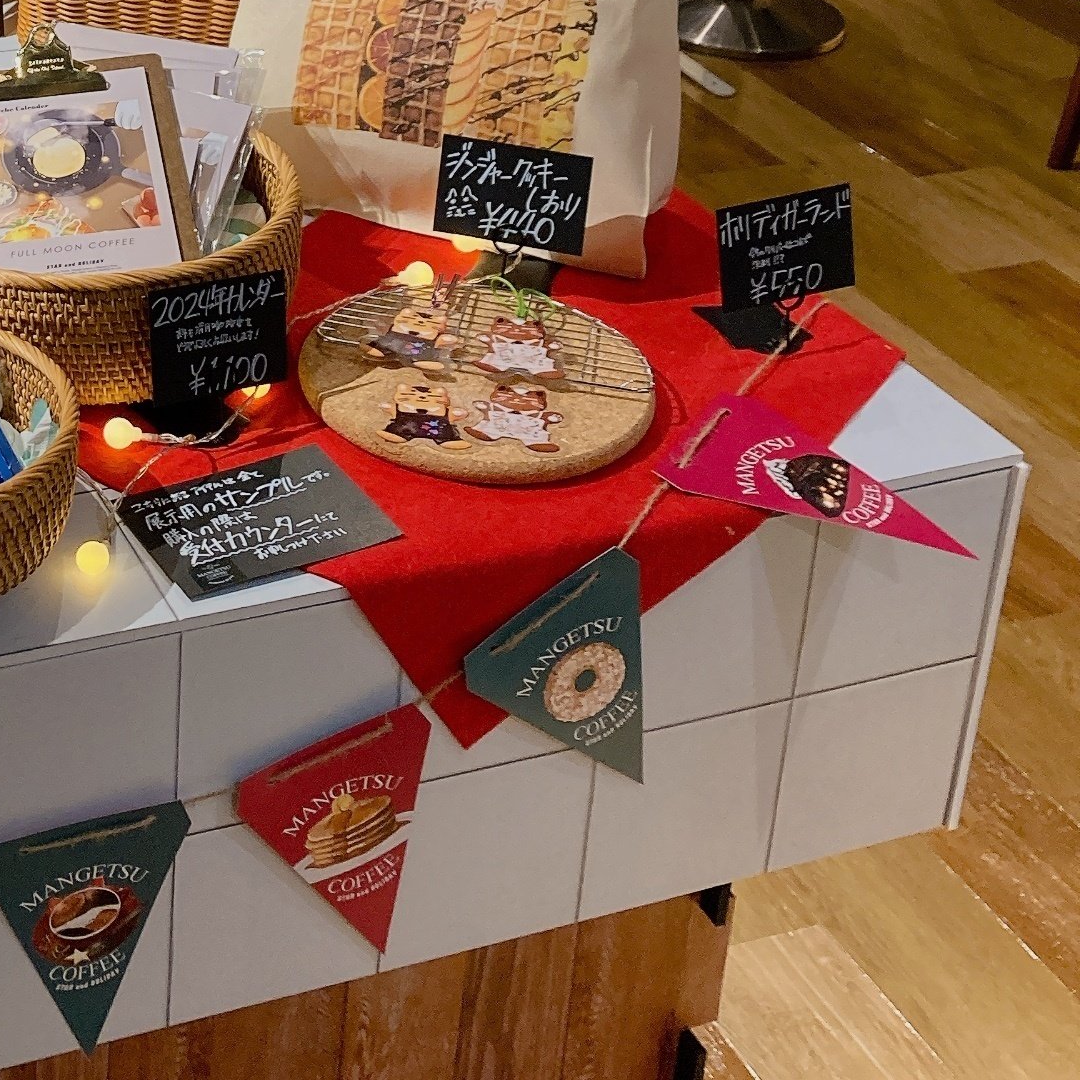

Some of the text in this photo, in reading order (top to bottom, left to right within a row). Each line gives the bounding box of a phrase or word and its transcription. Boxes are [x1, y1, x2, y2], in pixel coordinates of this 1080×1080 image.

[445, 141, 569, 190] ジンジャークッキー
[525, 186, 582, 221] しおり
[10, 237, 136, 258] FULL MOON COFFEE
[734, 435, 796, 496] MANGETSU
[145, 470, 331, 532] 展示用のサンプルです。
[841, 482, 882, 525] COFFEE
[162, 510, 259, 548] 購入の際は
[179, 511, 339, 560] 受付カウンターにて
[515, 616, 623, 698] MANGETSU
[572, 689, 639, 742] COFFEE
[282, 772, 405, 838] MANGETSU
[18, 862, 150, 914] MANGETSU
[326, 852, 401, 896] COFFEE
[48, 947, 127, 982] COFFEE
